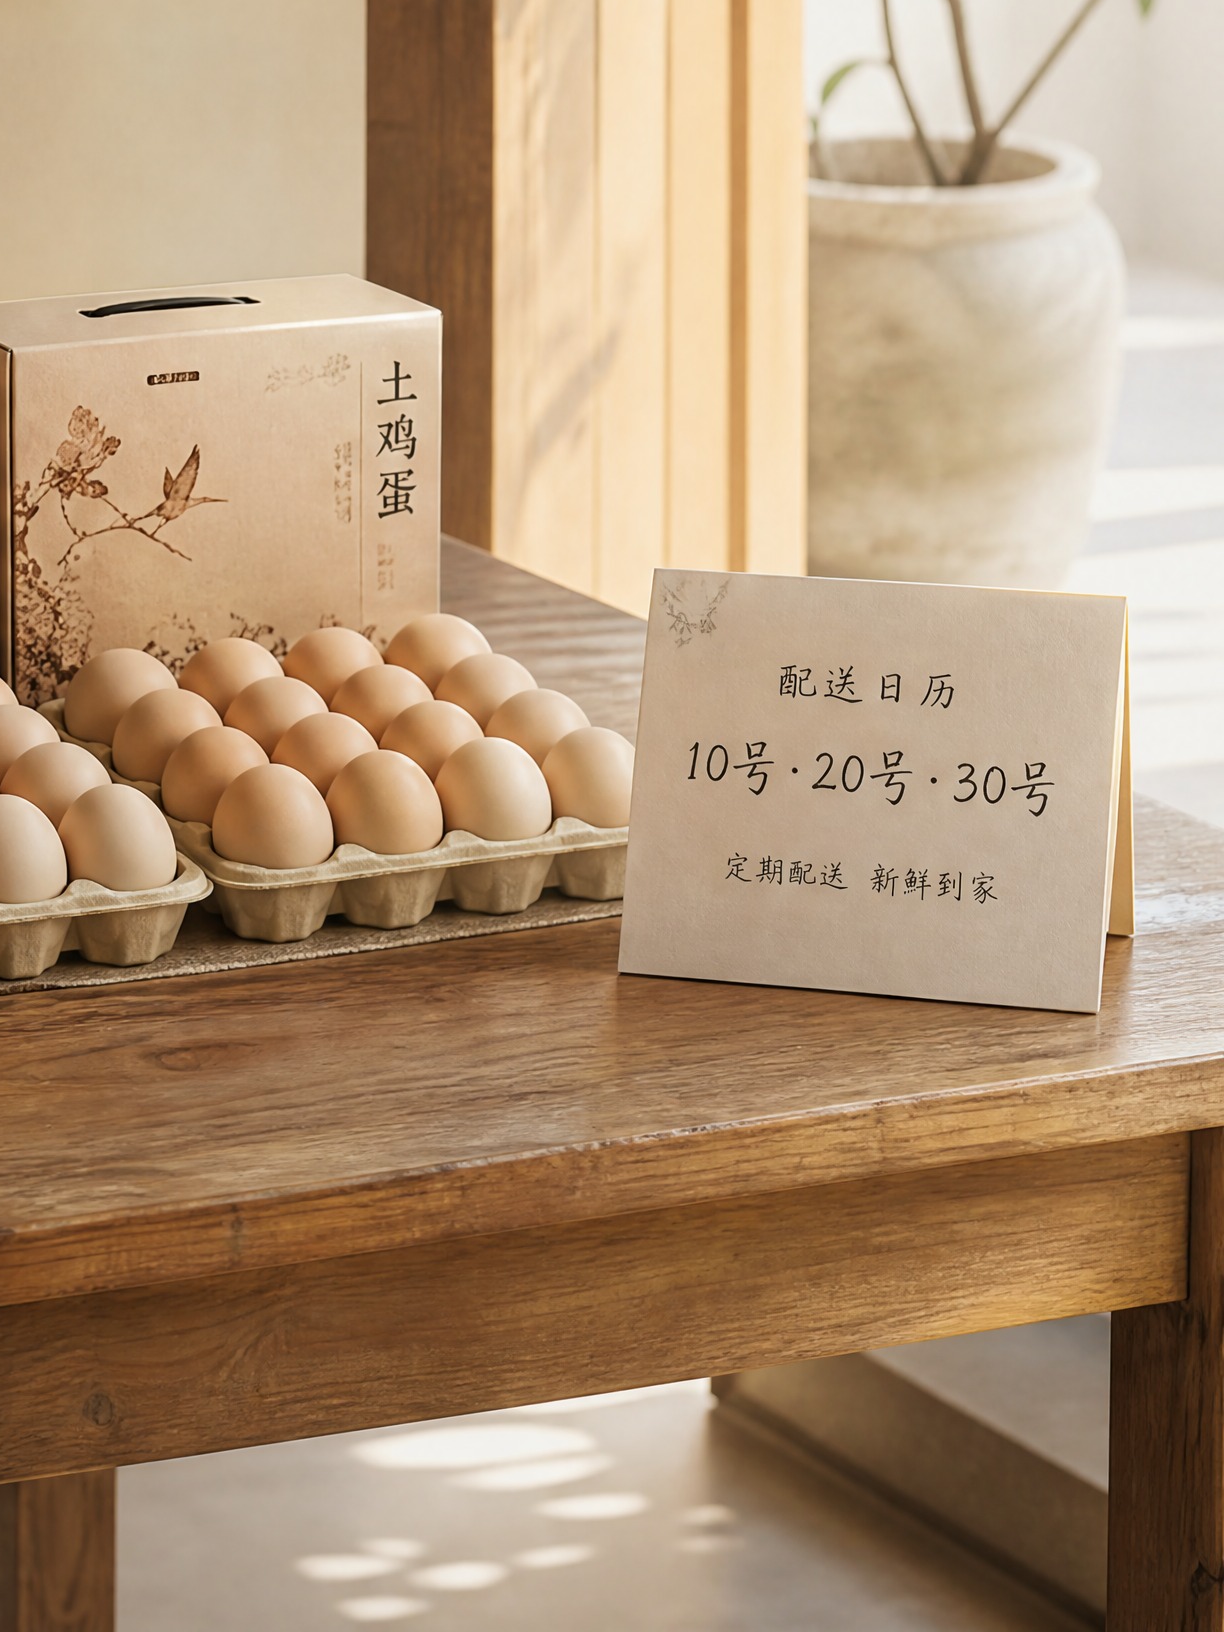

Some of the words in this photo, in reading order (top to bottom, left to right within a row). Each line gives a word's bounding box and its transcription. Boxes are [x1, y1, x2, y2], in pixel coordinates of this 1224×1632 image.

[375, 360, 417, 519] 土鸡蛋
[779, 665, 955, 709] 配送日历
[725, 852, 848, 890] 定期配送
